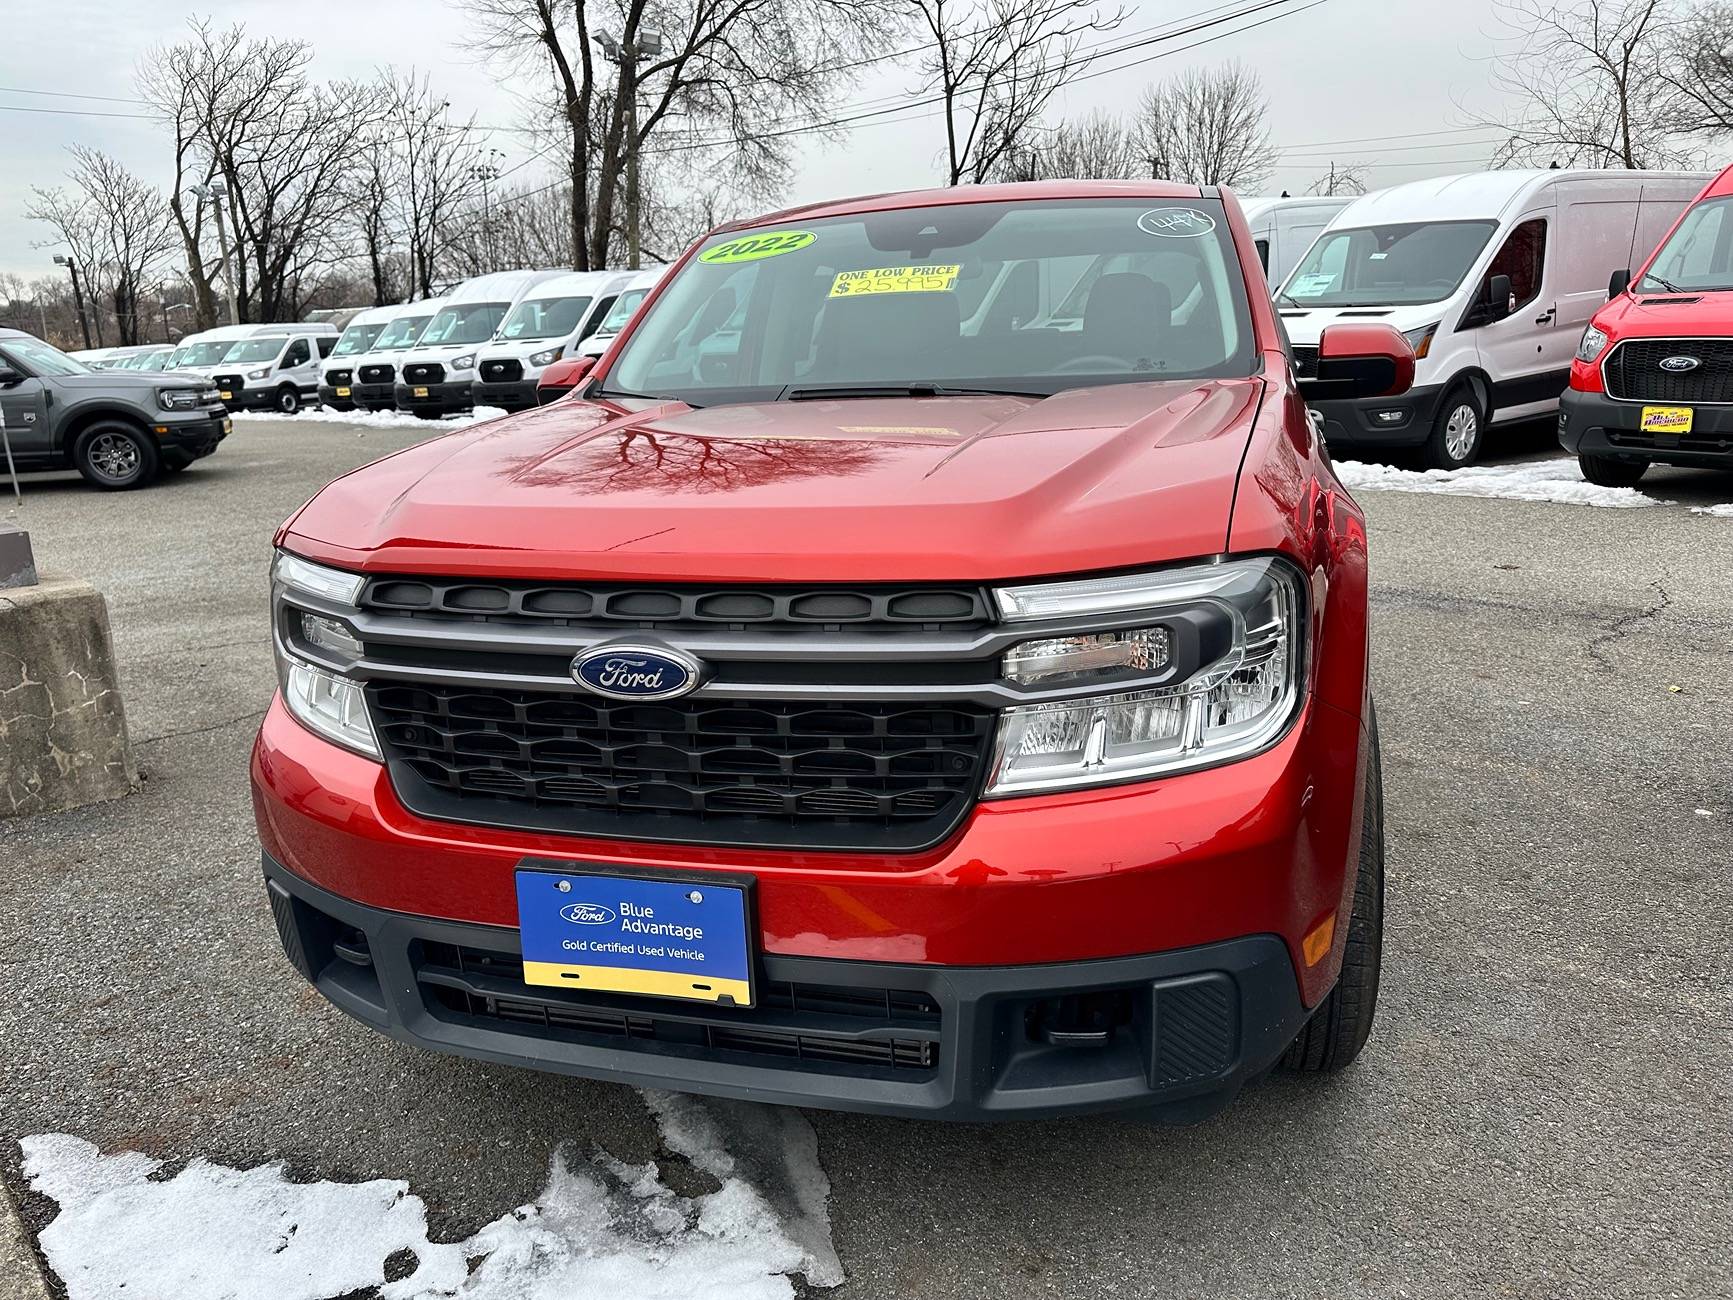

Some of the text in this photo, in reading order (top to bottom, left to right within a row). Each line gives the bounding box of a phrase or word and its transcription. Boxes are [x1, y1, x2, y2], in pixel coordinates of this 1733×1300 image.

[706, 233, 808, 260] 2022
[840, 265, 955, 281] ONE LOW PRICE
[600, 658, 663, 688] Ford
[571, 902, 654, 922] Ford Blue
[621, 918, 703, 940] Advantage
[562, 939, 705, 961] Gold Certified Used Vehicle
